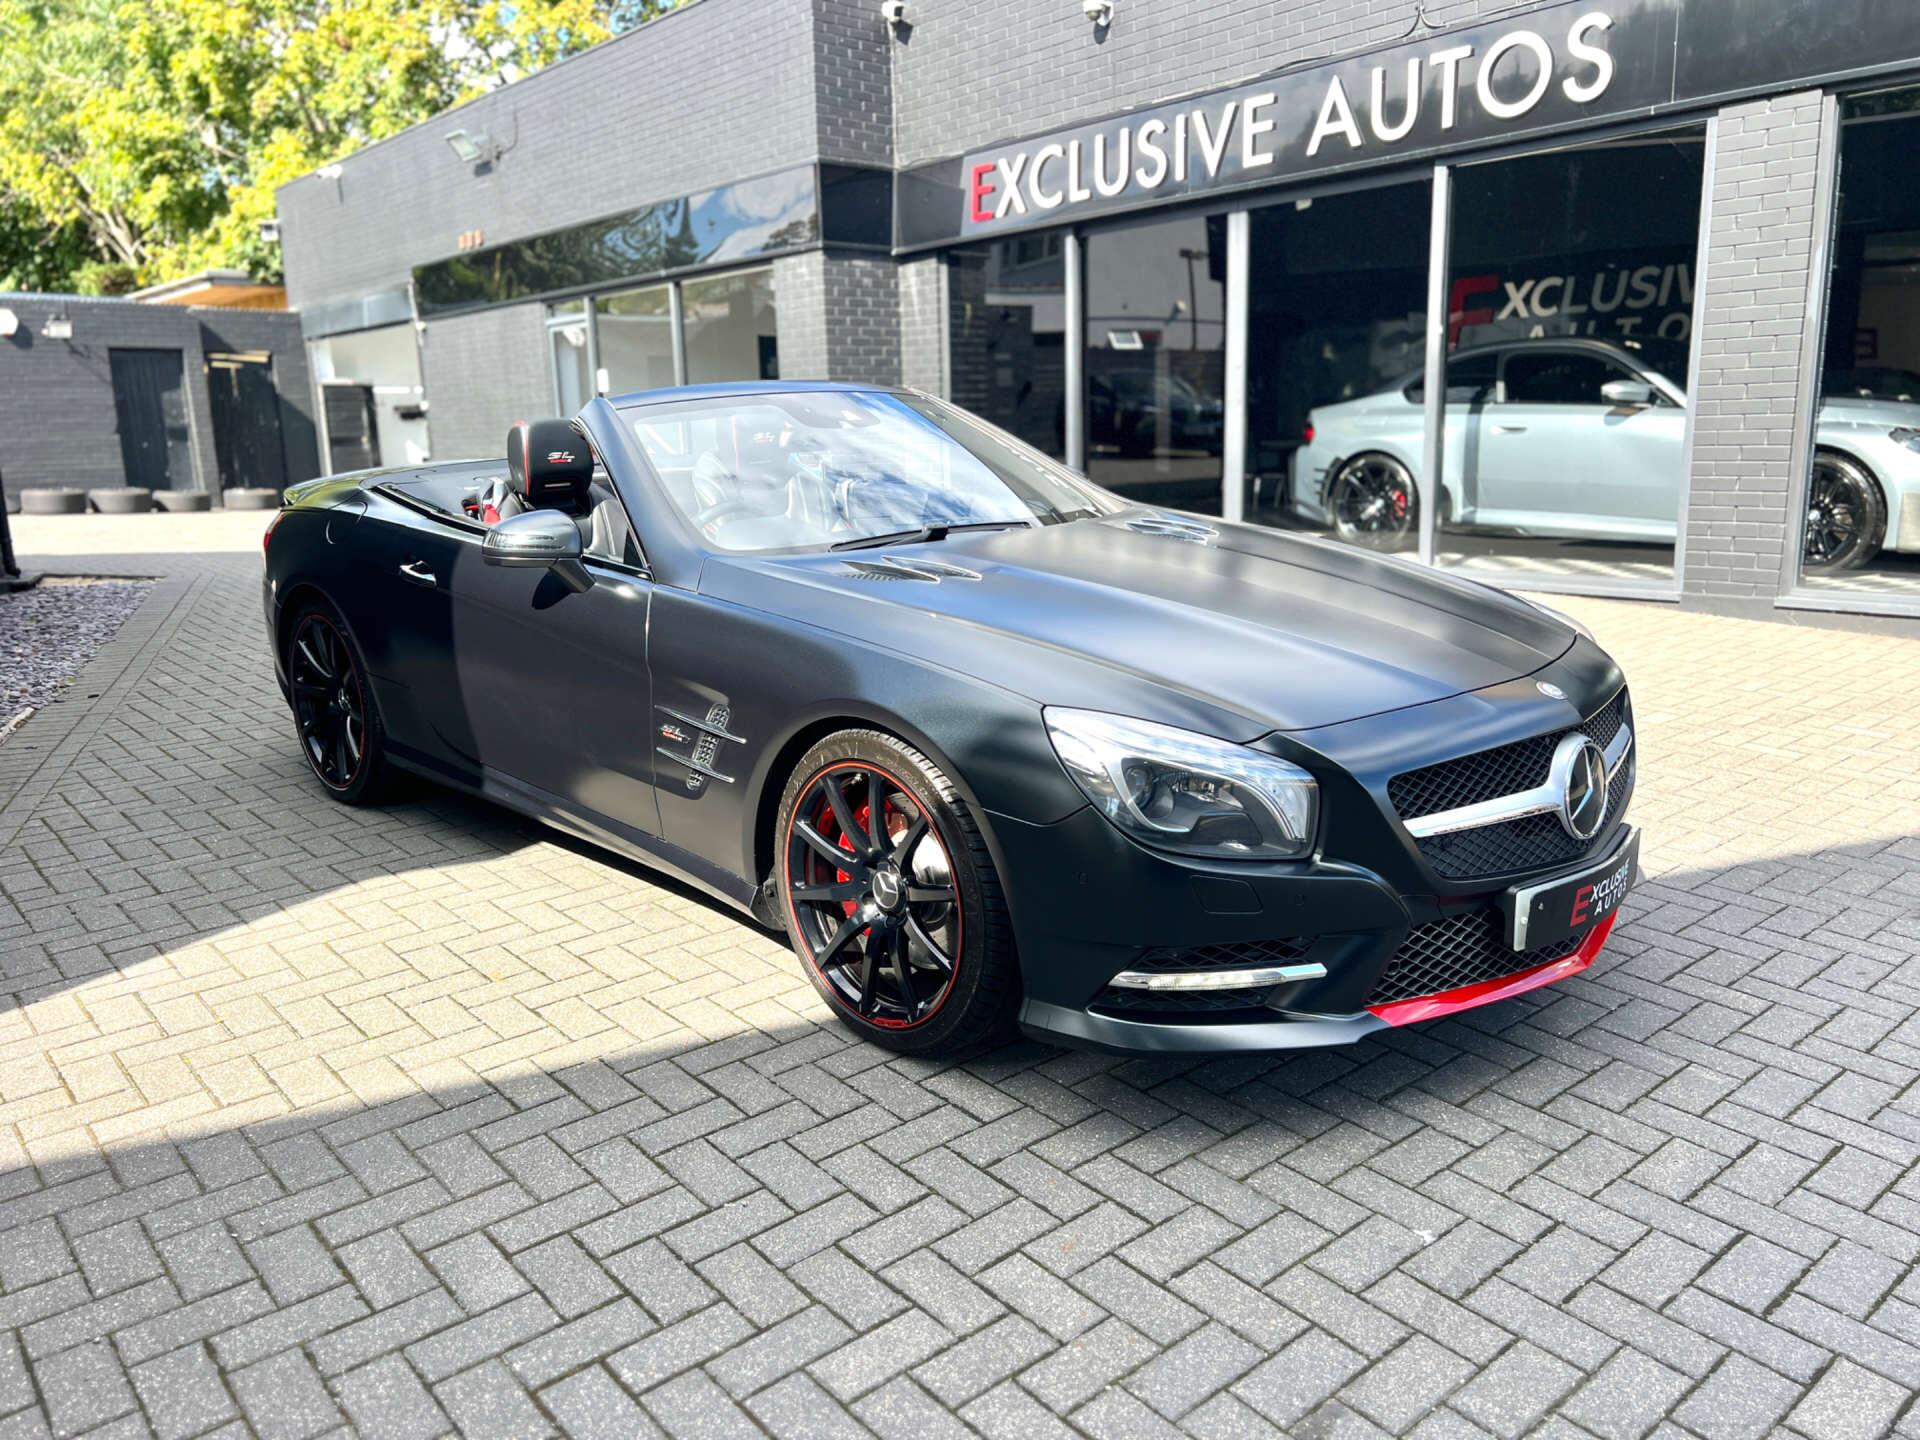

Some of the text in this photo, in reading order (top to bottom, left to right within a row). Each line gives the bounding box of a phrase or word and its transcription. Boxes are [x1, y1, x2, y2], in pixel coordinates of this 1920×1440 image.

[970, 11, 1614, 223] EXCLUSIVE AUTOS
[1569, 857, 1630, 927] EXCLUSIVE
[1594, 876, 1627, 916] AUTOS
